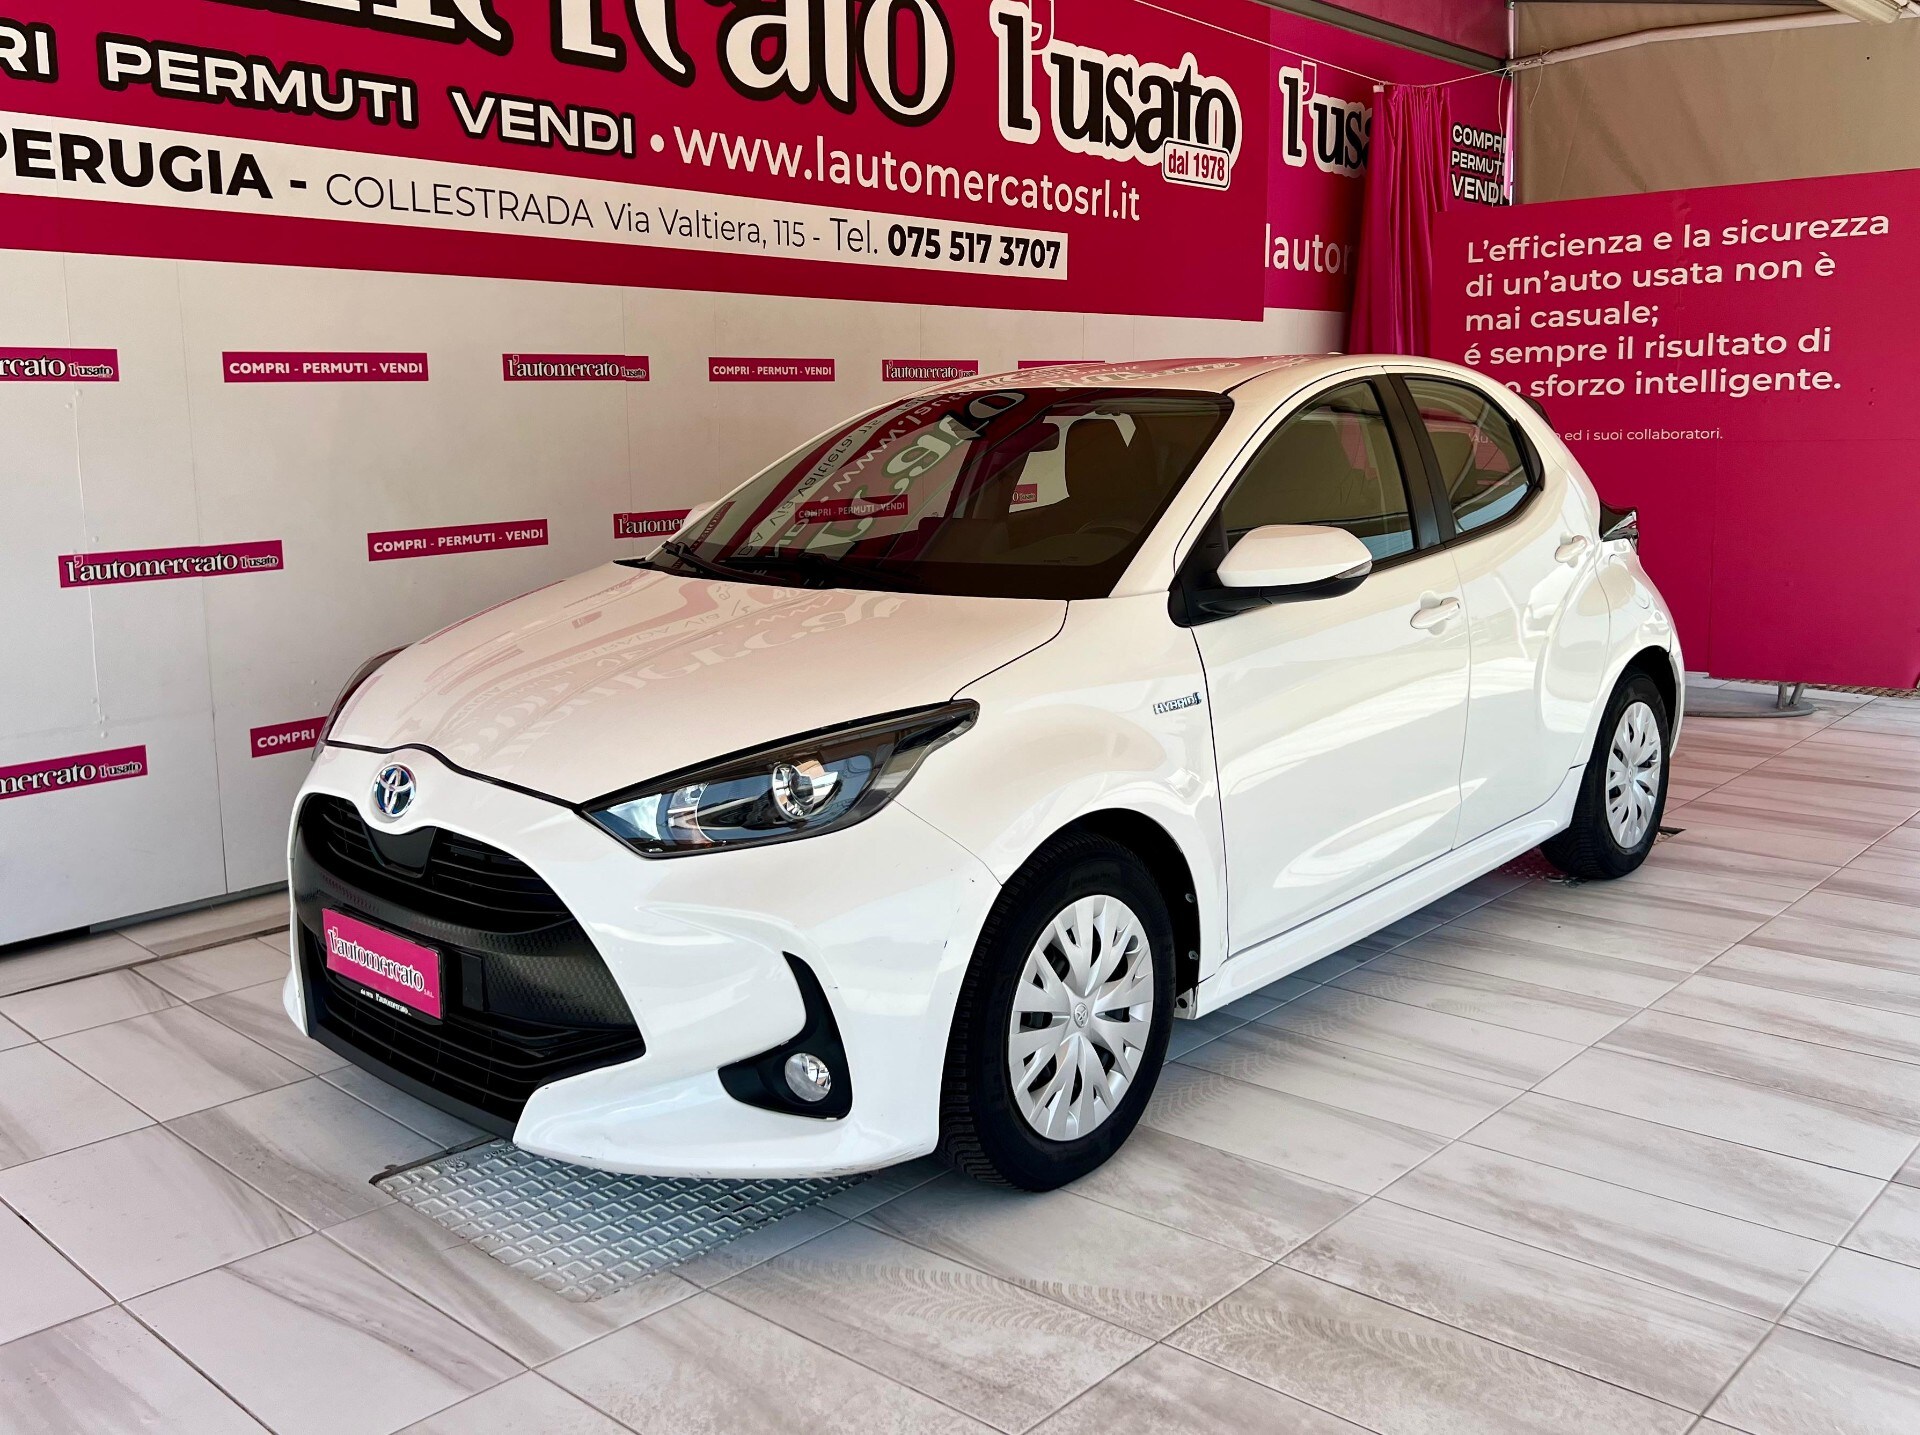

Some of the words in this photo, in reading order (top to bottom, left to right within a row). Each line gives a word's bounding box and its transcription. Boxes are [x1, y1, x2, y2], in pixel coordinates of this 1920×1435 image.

[104, 41, 413, 122] PERMUTI
[452, 92, 634, 154] VENDI
[673, 126, 1141, 221] www.lautomercatosrl.it
[1168, 149, 1188, 175] dal
[1194, 153, 1225, 181] 1978
[0, 127, 274, 199] ERUGIA
[326, 173, 594, 228] COLLESTRADA
[605, 202, 650, 233] Via
[658, 207, 767, 249] Valtiera,
[773, 219, 805, 247] 115
[830, 217, 878, 254] Tel.
[888, 223, 941, 260] 075
[949, 230, 992, 264] 517
[999, 235, 1061, 269] 3707
[1451, 173, 1504, 205] VENDI
[1467, 233, 1642, 264] L'efficienza
[1653, 231, 1673, 250] e
[1683, 224, 1711, 248] la
[1721, 215, 1889, 246] sicurezza
[1465, 273, 1493, 297] di
[1503, 269, 1622, 296] un'auto
[1632, 263, 1723, 288] usata
[1735, 258, 1803, 282] non
[1814, 251, 1836, 277] è
[1465, 306, 1521, 332] mai
[1530, 300, 1659, 329] casuale;
[1490, 342, 1608, 368] sempre
[1618, 335, 1634, 360] il
[1645, 332, 1788, 359] risultato
[1797, 326, 1832, 352] di
[229, 362, 290, 374] COMPRI
[302, 362, 369, 374] PERMUTI
[379, 362, 423, 374] VENDI
[507, 354, 620, 377] l'automercato
[712, 365, 750, 375] COMPRI
[757, 366, 798, 375] PERMUTI
[804, 366, 832, 375] VENDI
[1530, 373, 1625, 398] sforzo
[1635, 367, 1842, 399] intelligente.
[1564, 429, 1582, 441] ed
[1593, 429, 1623, 441] suoi
[1626, 427, 1724, 441] collaboratori.
[373, 538, 427, 553] COMPRI
[437, 533, 496, 548] PERMUTI
[505, 529, 543, 541] VENDI
[257, 729, 316, 748] COMPRI
[328, 926, 425, 991] l'automercato
